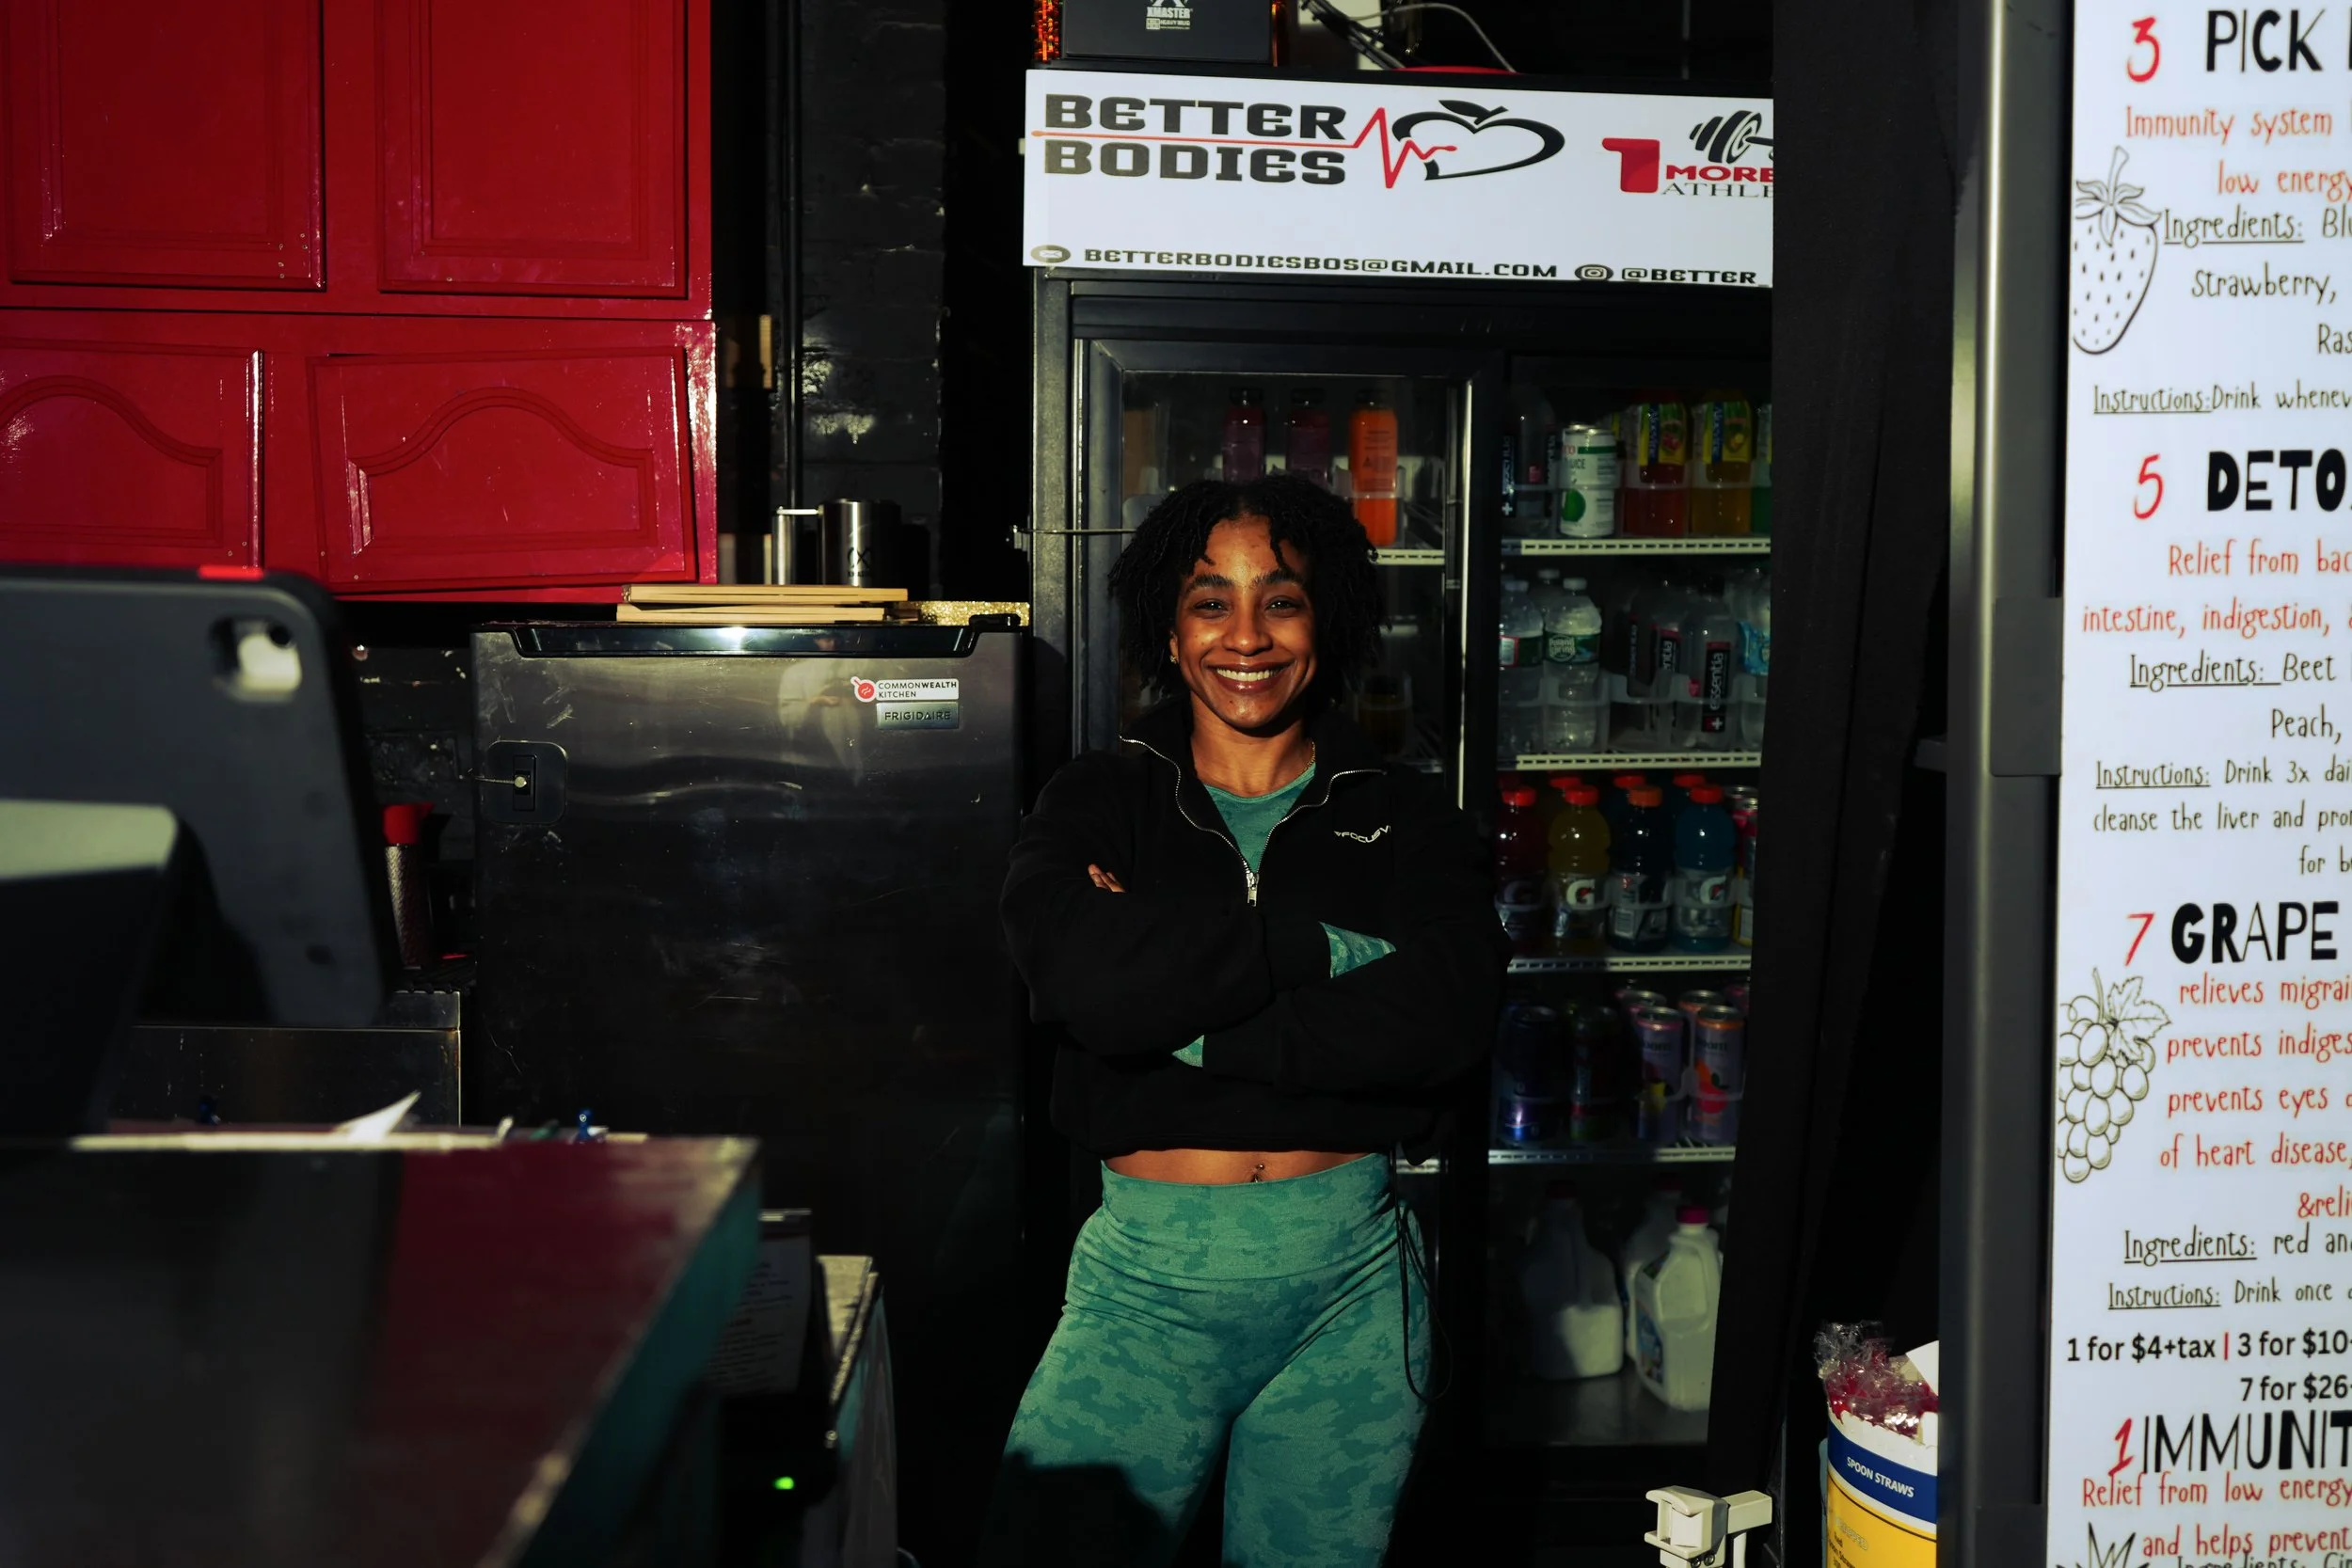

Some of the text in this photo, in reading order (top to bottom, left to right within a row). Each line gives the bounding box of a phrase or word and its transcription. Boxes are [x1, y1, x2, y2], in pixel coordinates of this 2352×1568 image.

[2126, 8, 2325, 82] 3 PICK
[1044, 92, 1349, 140] BETTER
[2125, 105, 2332, 146] Immunity system
[1044, 140, 1347, 185] BODIES
[2217, 161, 2259, 195] low
[2164, 204, 2304, 247] Ingredients:
[1084, 247, 1558, 279] BETTERBODIESBOS@GMAIL.COM
[2134, 448, 2352, 521] 5 DETO
[2169, 539, 2236, 576] Relief
[2247, 538, 2299, 576] from
[2083, 603, 2185, 639] intestine,
[2202, 596, 2330, 640] indigestion,
[878, 681, 957, 689] COMMONWEALTH
[1709, 651, 1724, 712] essentia
[2129, 648, 2337, 693] Ingredients: Beet
[884, 711, 951, 721] FRIGIDAIRE
[2271, 704, 2342, 744] Peach,
[2095, 754, 2352, 789] Instructions: Drink 3x dai
[2093, 803, 2159, 832] cleanse
[2171, 803, 2202, 831] the
[2217, 803, 2259, 830] liver
[2273, 800, 2305, 828] and
[2298, 845, 2326, 876] for
[2125, 901, 2339, 967] 7 GRAPE
[2180, 973, 2352, 1009] relieves migrai
[2167, 1031, 2262, 1064] prevents
[2168, 1086, 2263, 1118] prevents
[2279, 1087, 2328, 1117] eyes
[2160, 1132, 2185, 1169] of
[2196, 1134, 2255, 1167] heart
[2297, 1185, 2352, 1219] &reli
[2124, 1225, 2257, 1267] Ingredients:
[2273, 1222, 2311, 1255] red
[2108, 1281, 2222, 1310] Instructions:
[2234, 1277, 2281, 1305] Drink
[2295, 1281, 2332, 1302] once
[2067, 1338, 2080, 1362] 1
[2088, 1336, 2125, 1360] for
[2132, 1332, 2217, 1364] $4+tax
[2237, 1333, 2251, 1357] 3
[2259, 1330, 2296, 1356] for
[2240, 1377, 2252, 1402] 7
[2260, 1376, 2296, 1402] for
[2108, 1410, 2352, 1477] 1 IMMUNIT
[1847, 1456, 1915, 1497] SPOON STRAWS
[2082, 1471, 2145, 1507] Relief
[2157, 1471, 2208, 1505] from
[2224, 1471, 2264, 1503] low
[2143, 1523, 2352, 1560] and helps prevent
